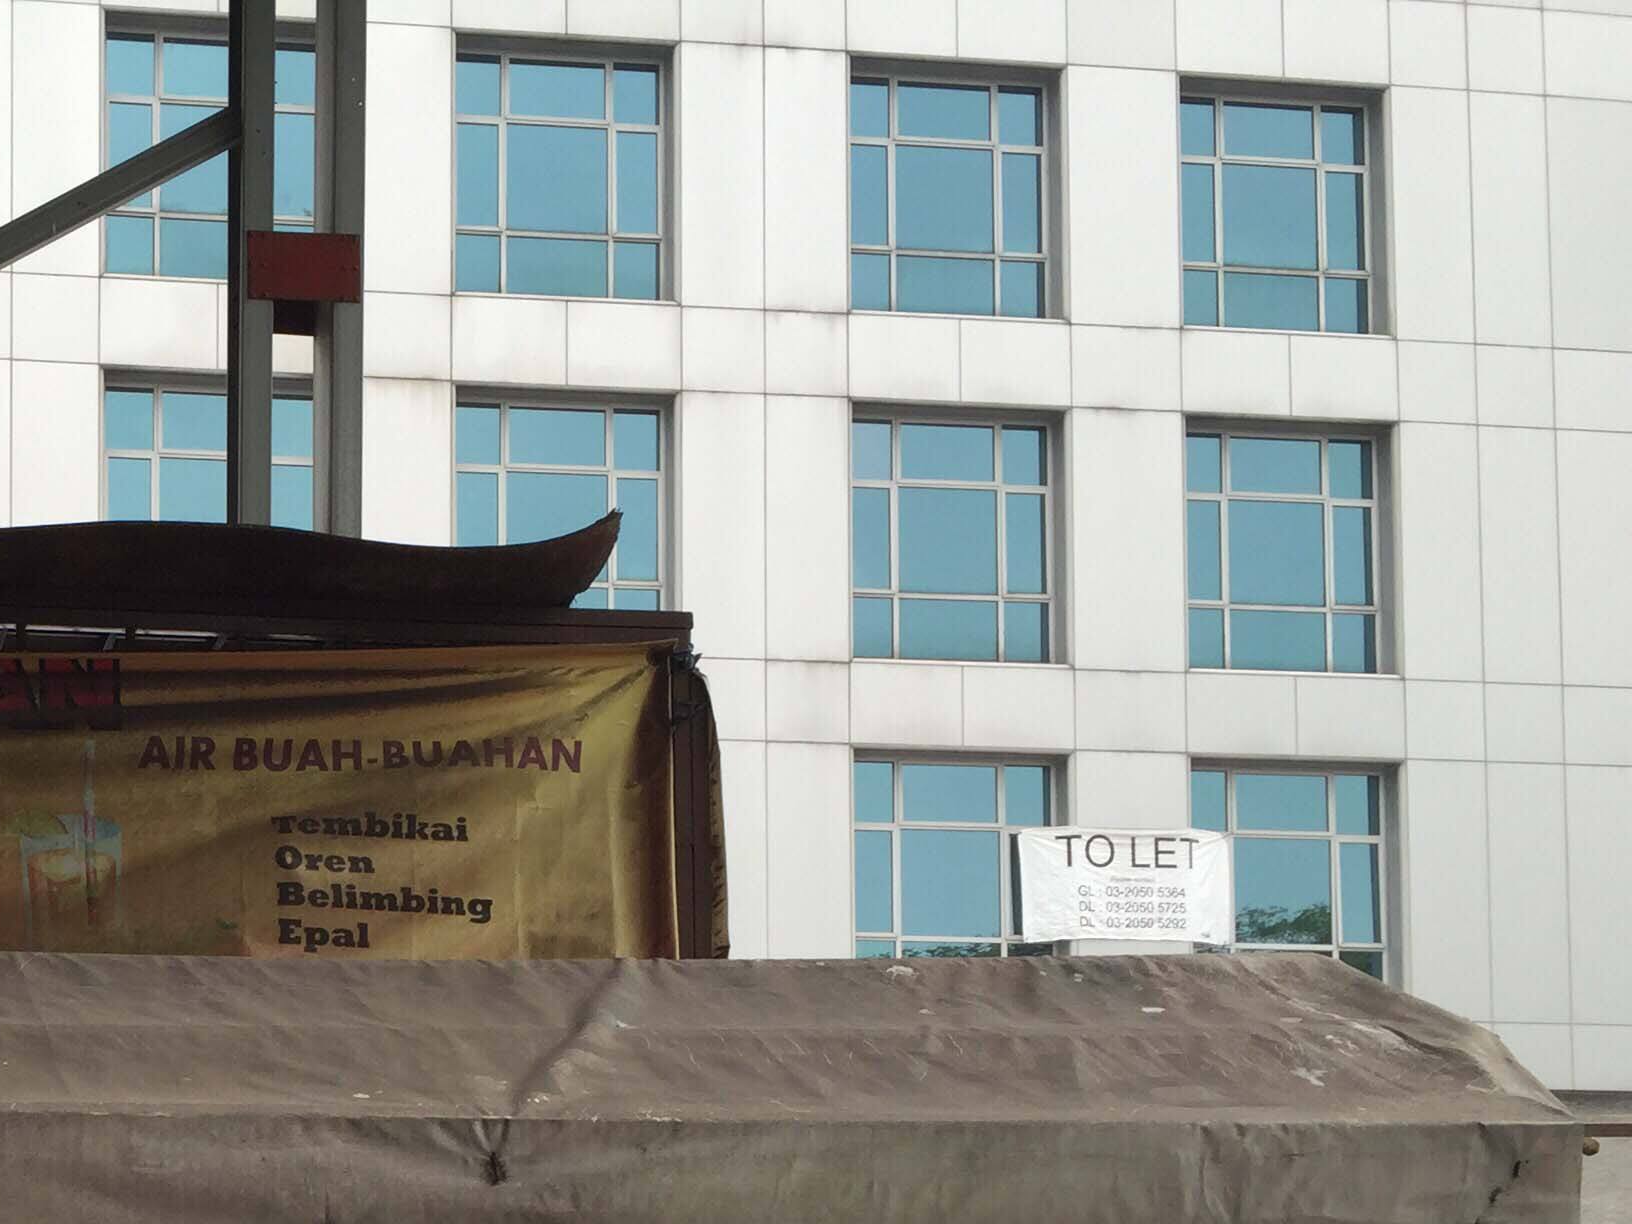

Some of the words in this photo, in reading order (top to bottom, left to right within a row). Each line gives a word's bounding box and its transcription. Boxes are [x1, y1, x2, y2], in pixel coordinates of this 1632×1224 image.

[137, 736, 217, 770] AIR
[232, 737, 583, 773] BUAH-BUAHAN
[271, 812, 469, 842] Tembikai
[275, 845, 375, 874] Oren
[1055, 834, 1116, 868] TO
[1130, 836, 1200, 869] LET
[277, 882, 494, 923] Belimbing
[277, 918, 369, 952] Epal
